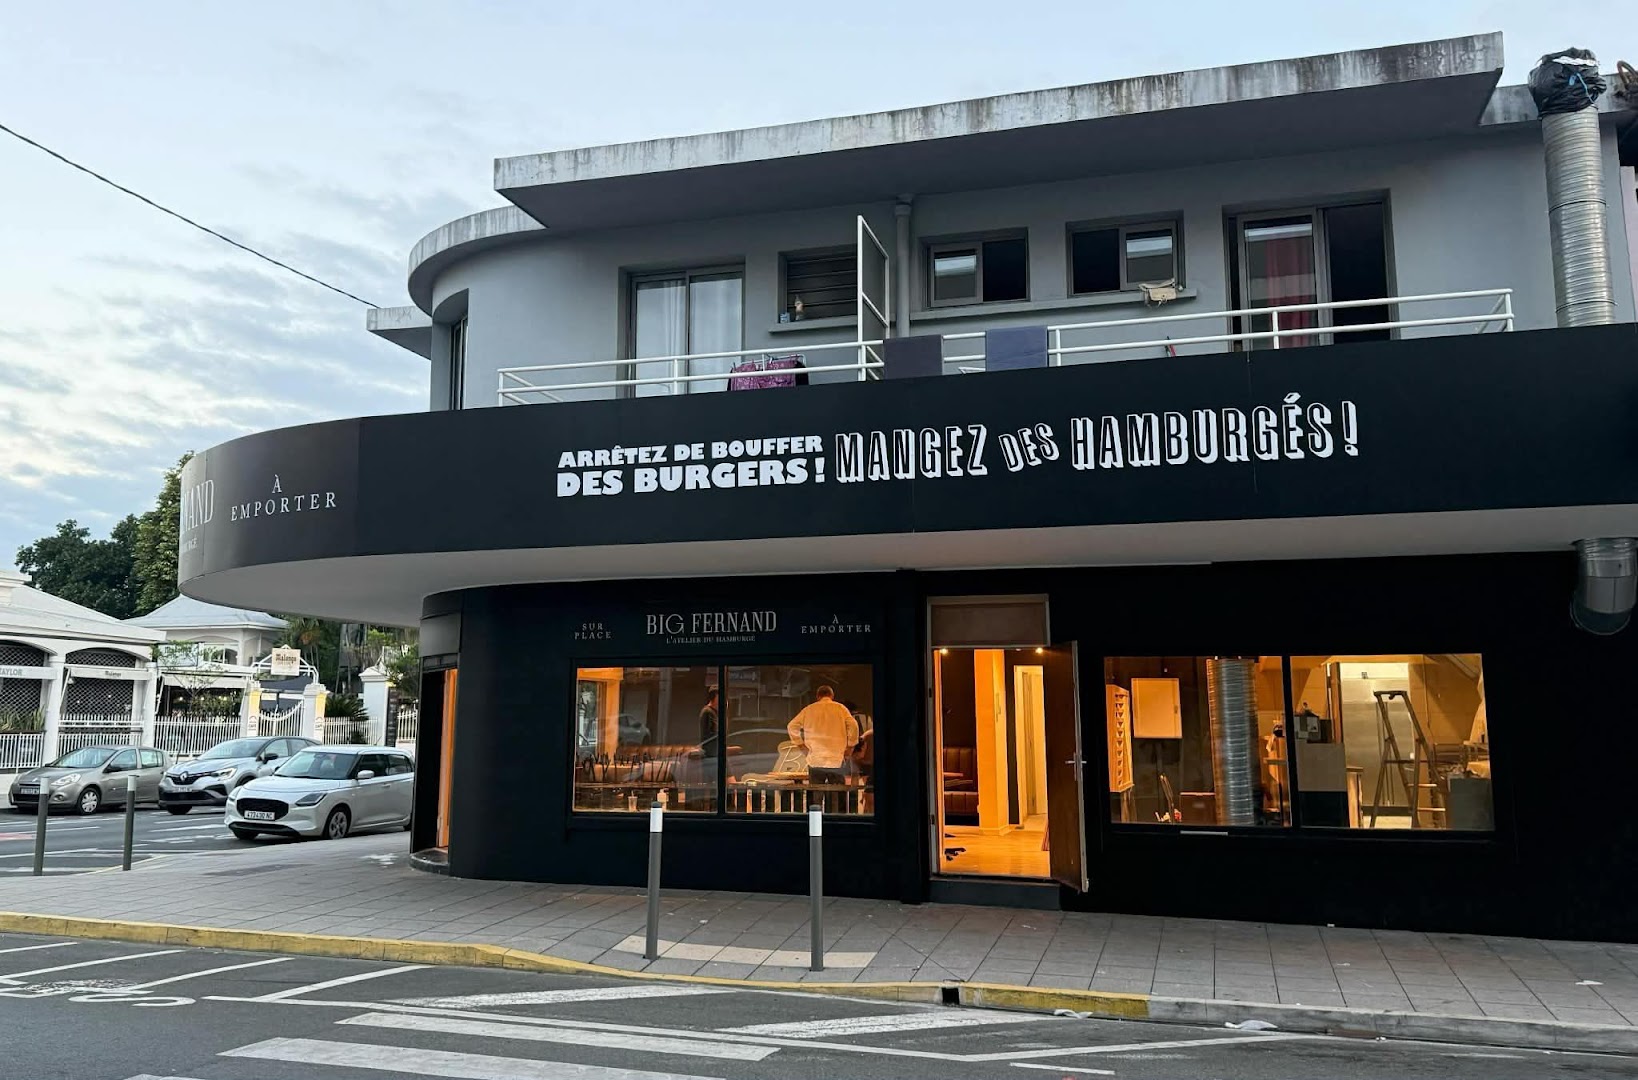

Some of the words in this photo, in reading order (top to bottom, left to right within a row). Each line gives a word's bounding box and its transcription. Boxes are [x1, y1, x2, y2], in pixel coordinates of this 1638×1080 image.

[557, 444, 667, 468] ARRÊTEZ
[673, 443, 705, 461] DE
[711, 435, 824, 459] BOUFFER
[835, 424, 988, 484] MANGEZ
[998, 422, 1060, 473] DES
[271, 474, 282, 494] À
[556, 470, 624, 498] DES
[230, 491, 337, 522] EMPORTER
[582, 622, 604, 631] SUR
[646, 613, 685, 635] BIG
[690, 610, 777, 634] FERNAND
[800, 624, 872, 634] EMPORTER
[574, 631, 612, 640] PLACE
